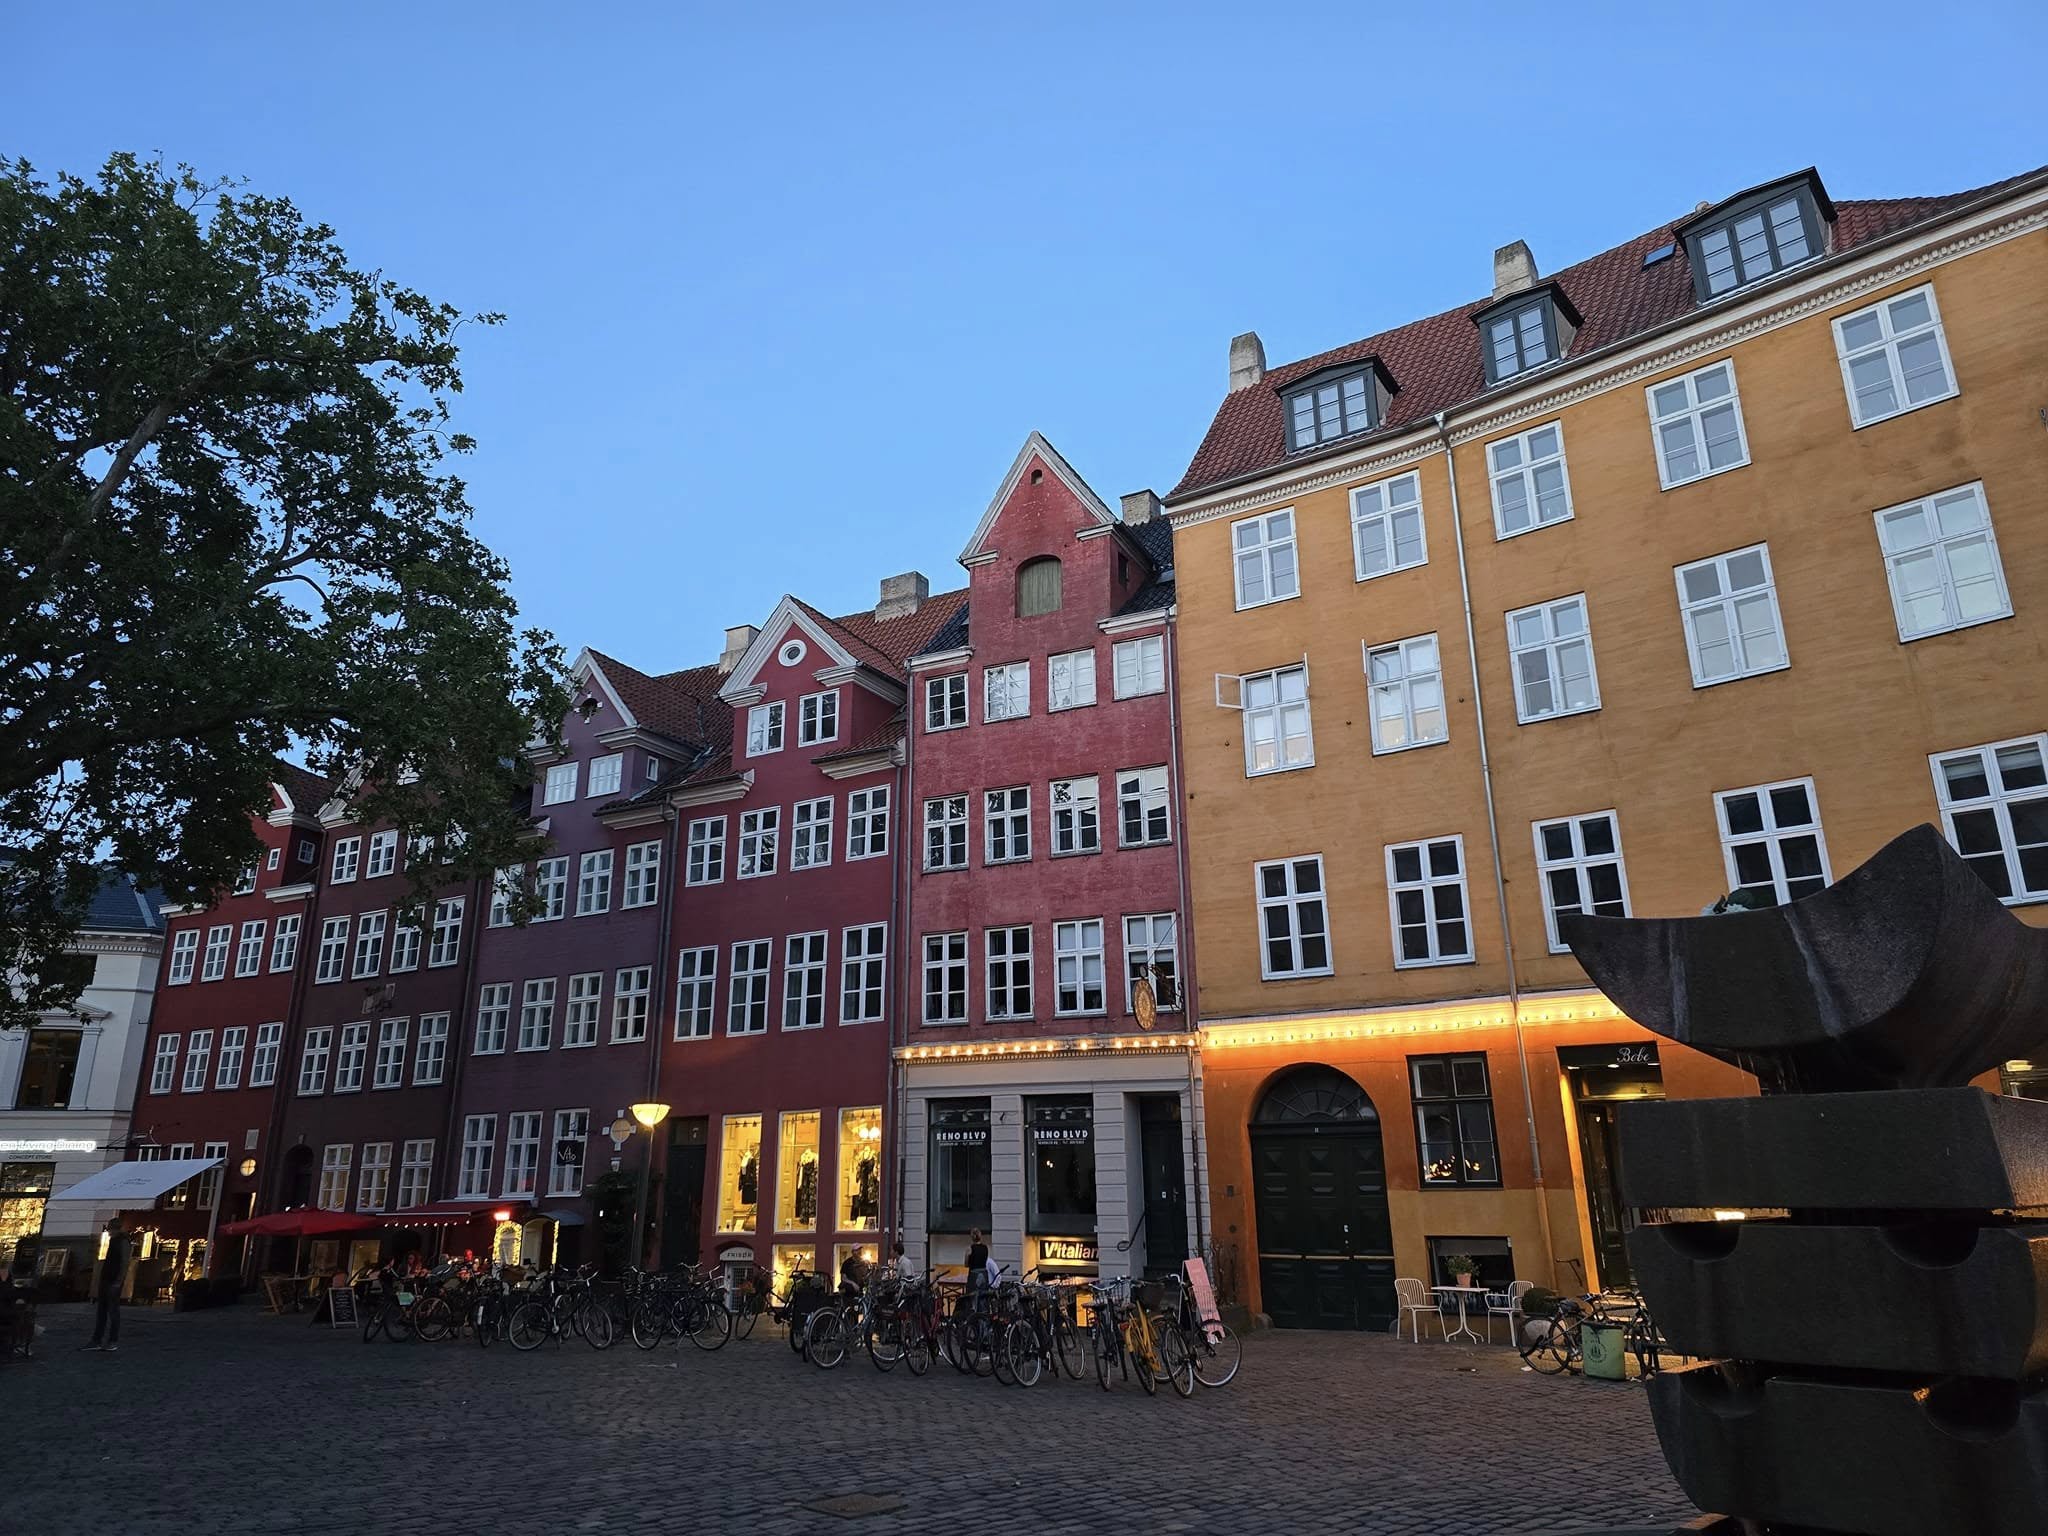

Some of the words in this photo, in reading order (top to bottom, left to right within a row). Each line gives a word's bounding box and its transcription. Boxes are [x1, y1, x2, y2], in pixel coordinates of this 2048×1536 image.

[1616, 1046, 1650, 1062] Bobe
[936, 1131, 961, 1140] RENO
[963, 1131, 986, 1139] BLVD
[1034, 1130, 1060, 1139] RENO
[1063, 1130, 1088, 1138] BLVD
